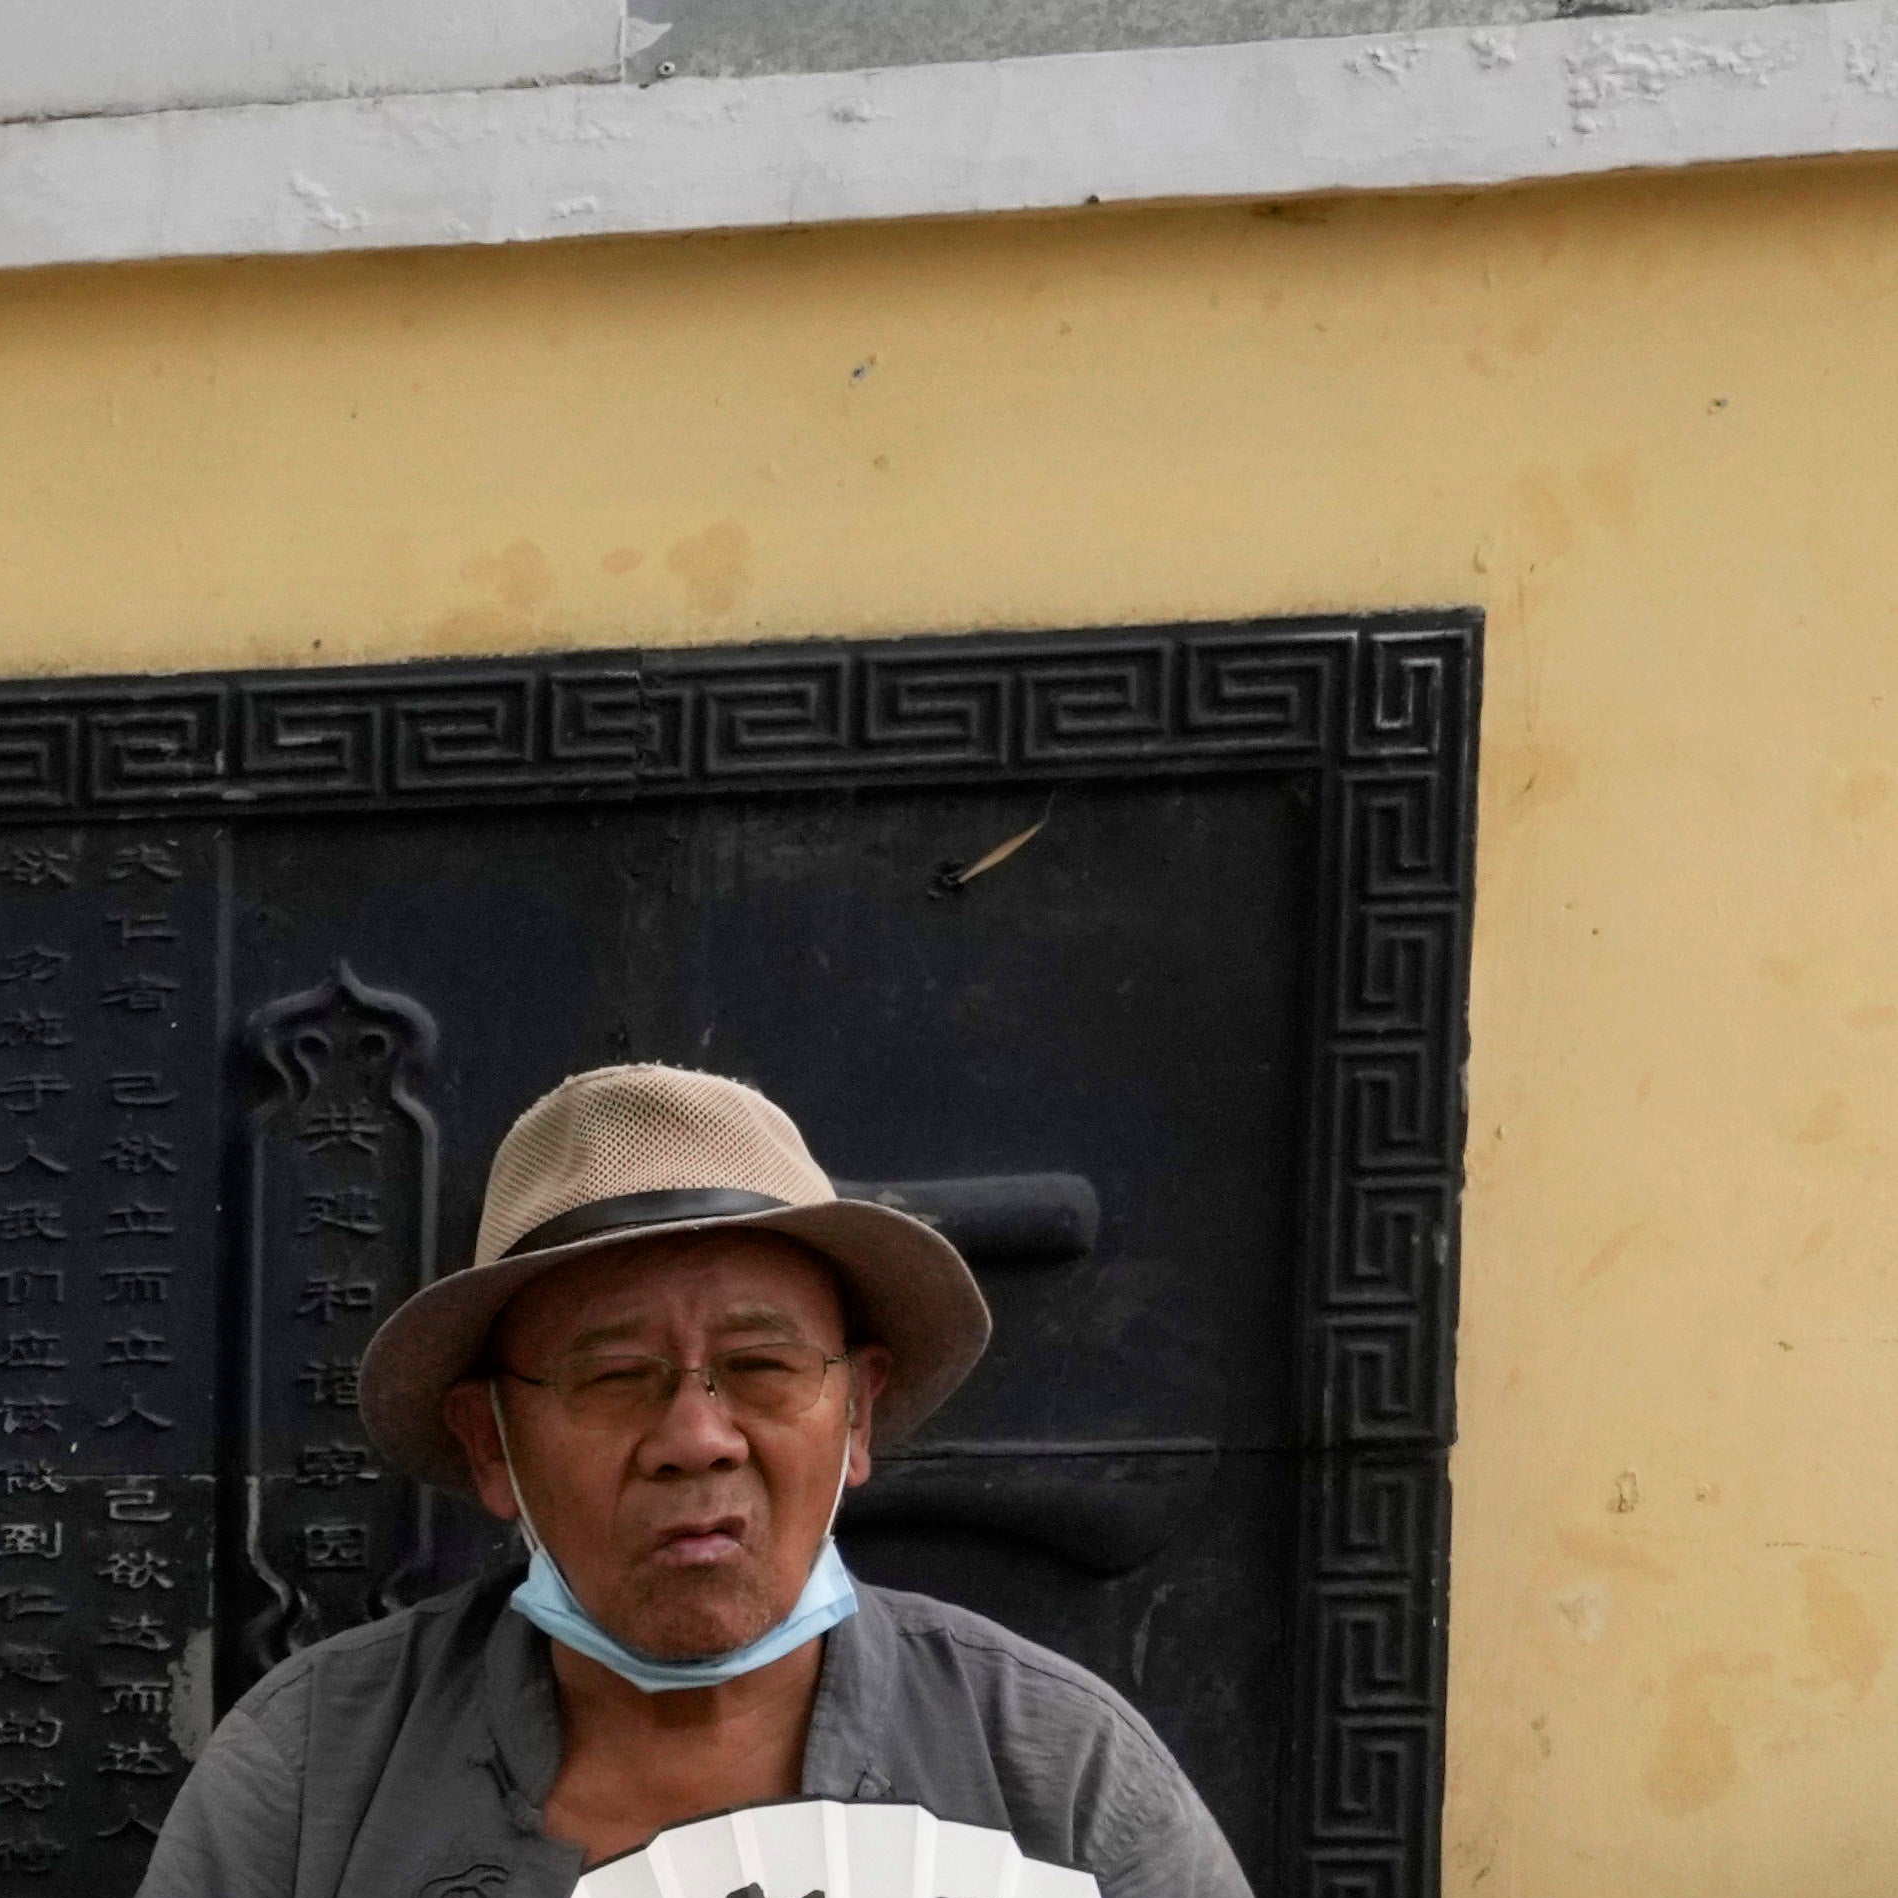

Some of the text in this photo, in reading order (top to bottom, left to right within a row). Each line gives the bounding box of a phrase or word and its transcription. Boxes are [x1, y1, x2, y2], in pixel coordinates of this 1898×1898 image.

[293, 1098, 385, 1571] 共建和谐家园
